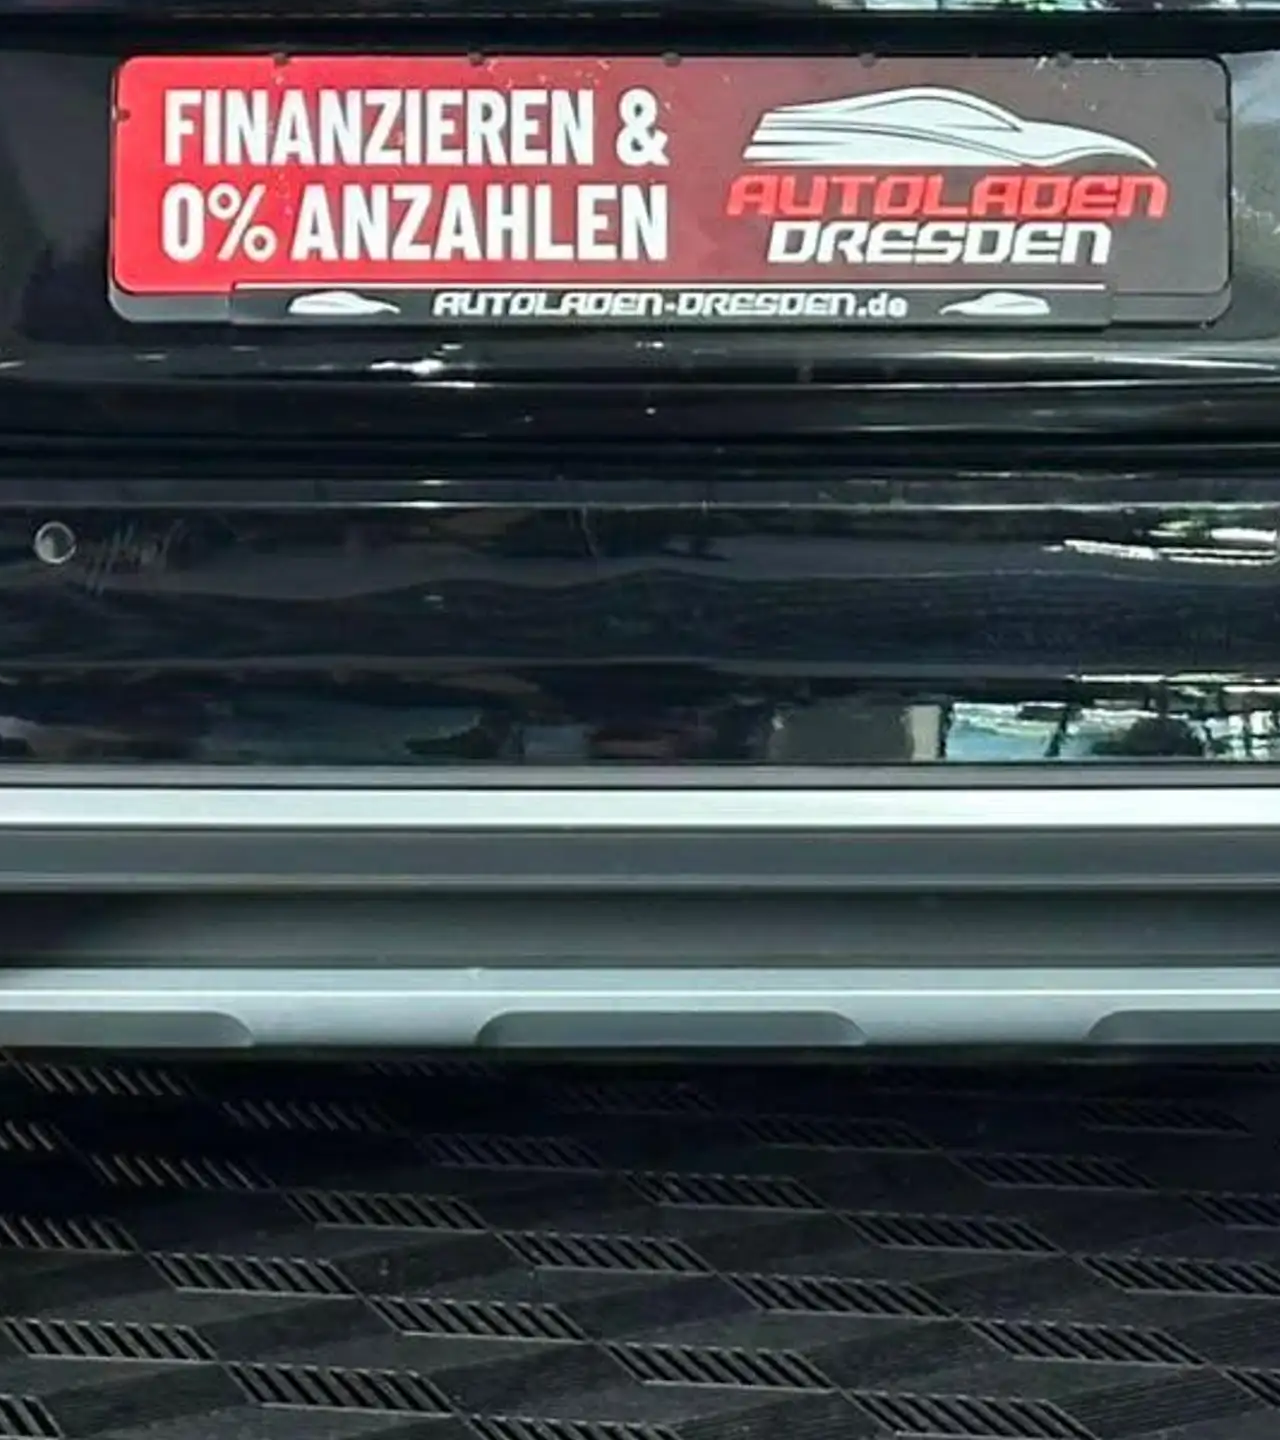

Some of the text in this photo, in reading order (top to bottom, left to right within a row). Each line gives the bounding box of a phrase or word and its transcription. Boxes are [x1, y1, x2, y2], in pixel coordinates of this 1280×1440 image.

[164, 88, 669, 166] FINANZIEREN &
[727, 175, 1168, 217] AUTOLADEN
[162, 184, 668, 261] 0% ANZAHLEN
[767, 221, 1112, 264] DRESDEN
[433, 291, 907, 317] AUTOLADEN-DRESDEN.de
